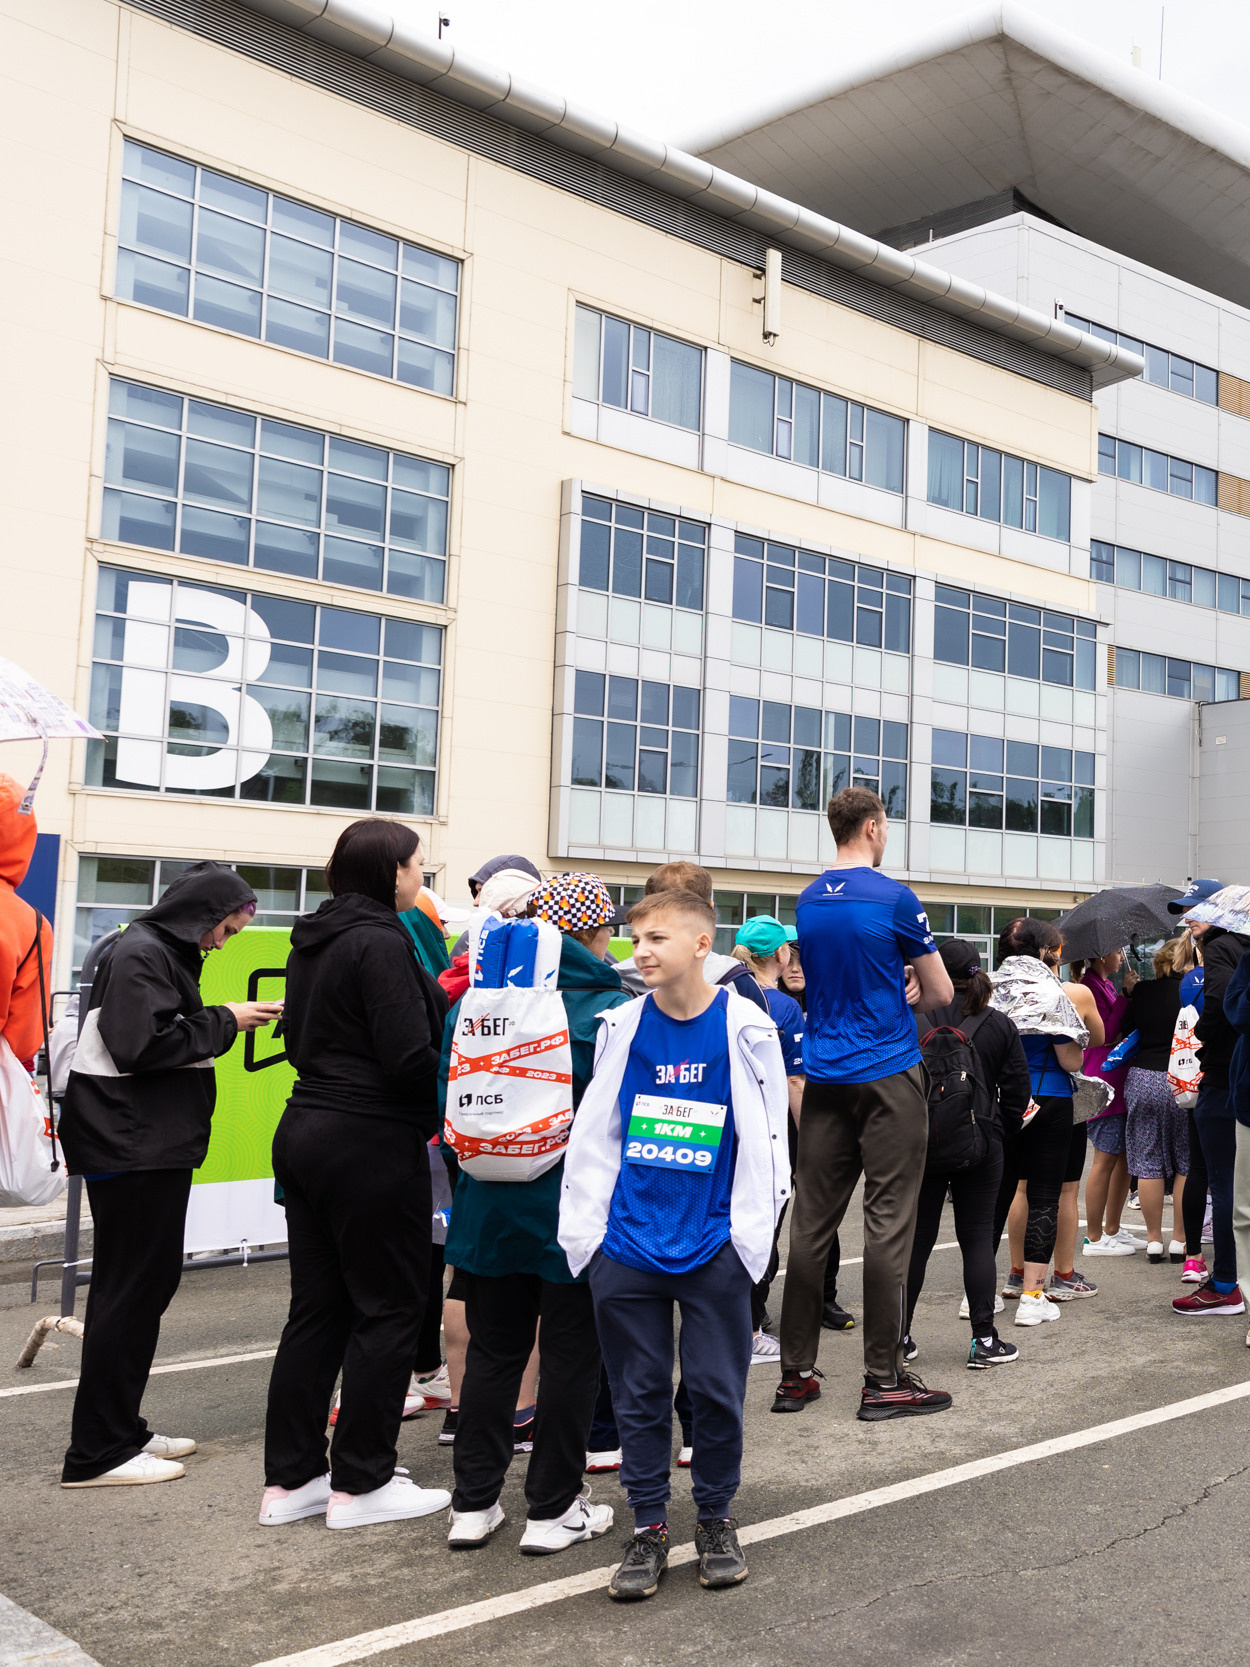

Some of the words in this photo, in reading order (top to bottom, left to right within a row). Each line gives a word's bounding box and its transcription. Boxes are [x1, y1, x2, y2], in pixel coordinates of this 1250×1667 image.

[116, 580, 273, 790] B
[462, 1013, 509, 1036] ЗАБЕГ
[490, 1034, 565, 1065] ЗАБЕГ.РФ
[525, 1070, 557, 1080] 2023
[655, 1062, 707, 1085] ЗАБЕГ
[475, 1093, 504, 1106] ПСБ
[626, 1141, 713, 1167] 20409
